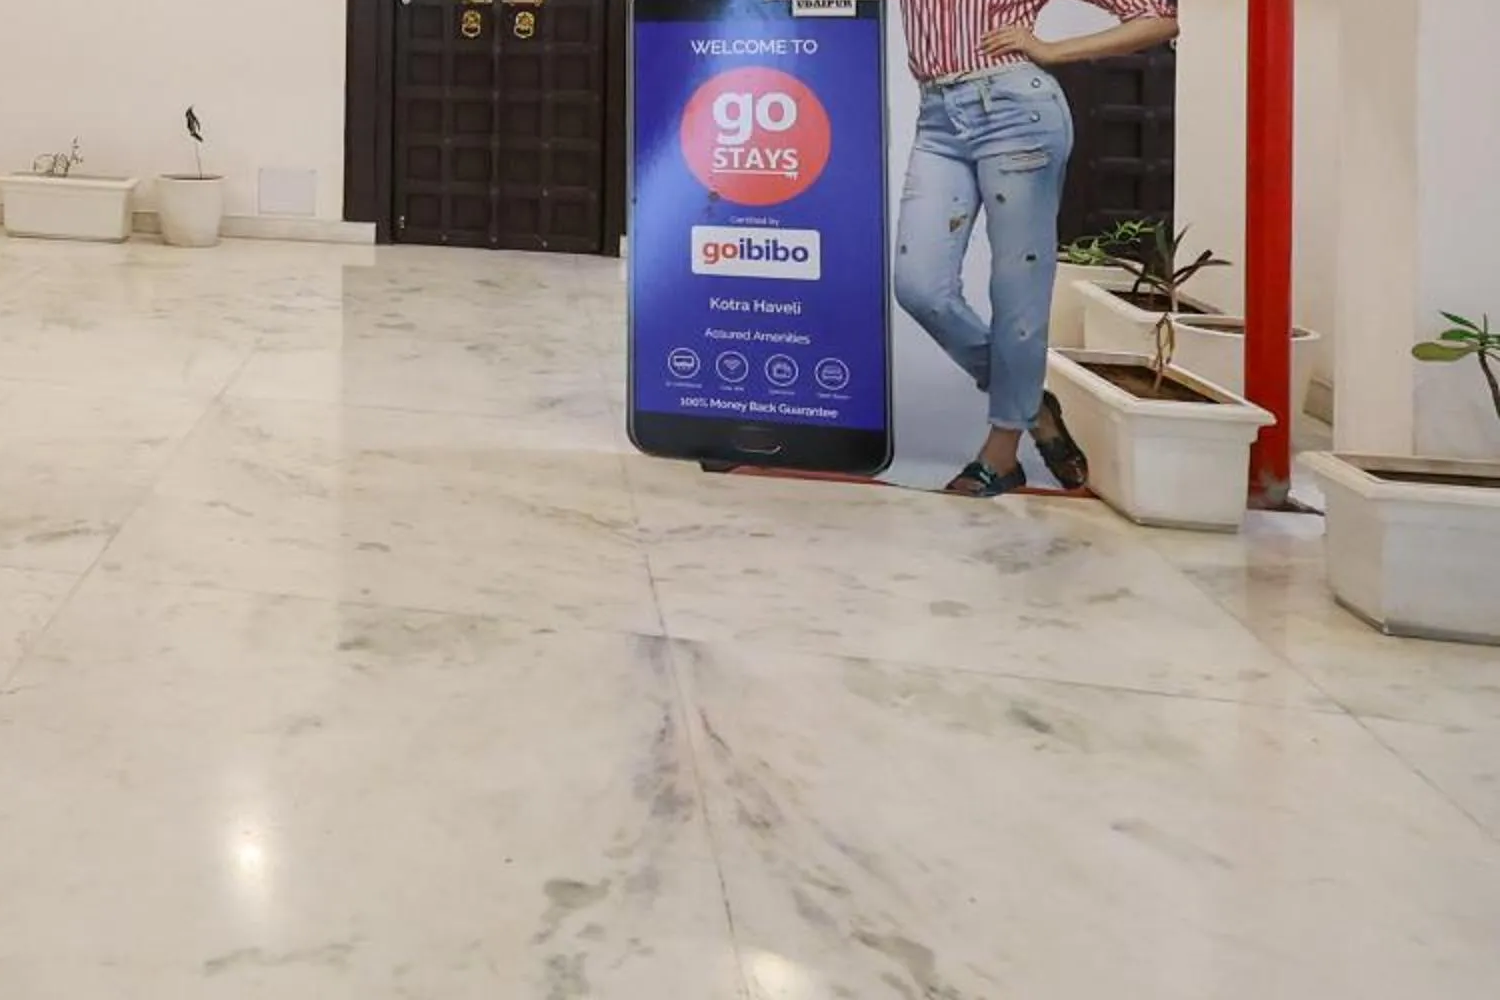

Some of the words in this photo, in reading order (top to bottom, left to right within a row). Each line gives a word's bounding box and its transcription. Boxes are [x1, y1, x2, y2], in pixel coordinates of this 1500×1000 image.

[690, 39, 787, 55] WELCOME
[791, 39, 818, 55] TO
[712, 90, 798, 146] go
[712, 147, 799, 170] STAYS
[702, 238, 809, 265] goibibo
[709, 296, 750, 312] Kotra
[753, 299, 802, 315] Haveli
[704, 327, 751, 342] Assured
[753, 330, 811, 346] Amenities
[710, 398, 747, 413] Money
[749, 401, 777, 414] Back
[778, 403, 840, 419] Guarantee
